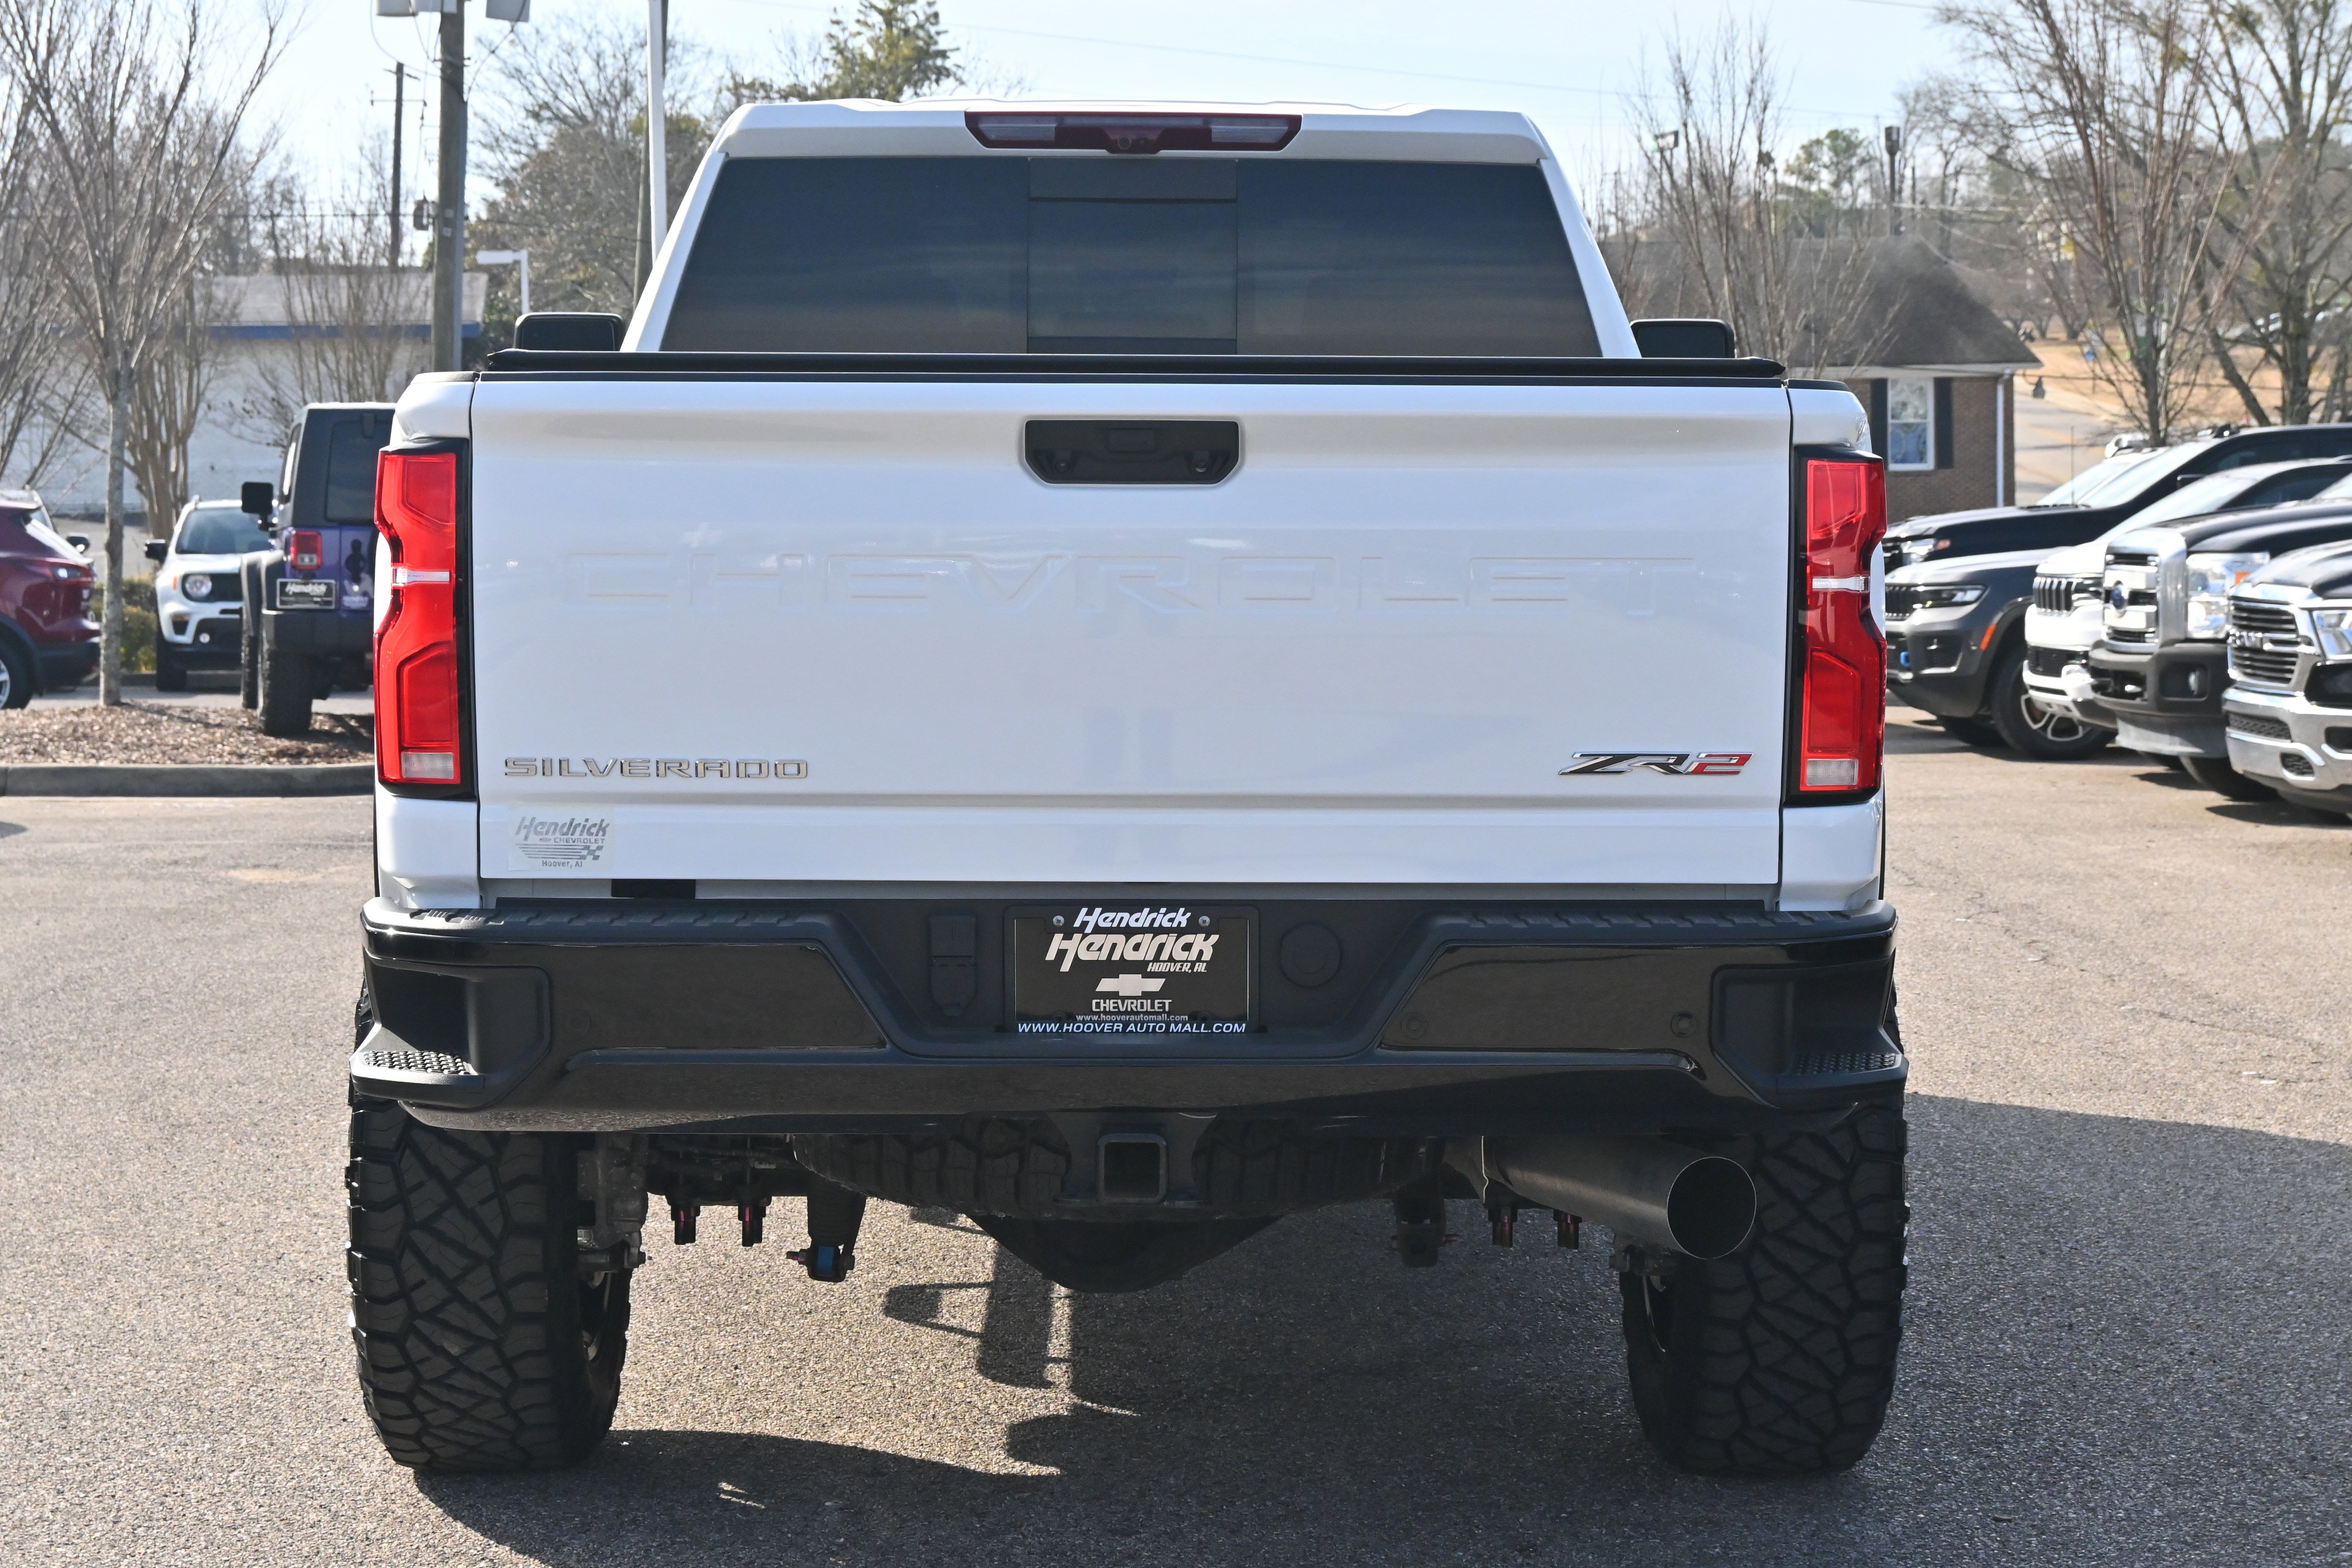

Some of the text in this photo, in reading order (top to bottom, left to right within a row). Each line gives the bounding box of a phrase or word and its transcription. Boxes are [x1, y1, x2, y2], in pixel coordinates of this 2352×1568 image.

[565, 552, 1696, 614] CHEVROLET
[505, 758, 808, 779] SILVERADO
[1558, 751, 1754, 776] ZR2
[515, 817, 610, 841] Hendrick
[542, 860, 572, 868] Hoover,
[1073, 908, 1191, 933] Hendrick
[1045, 934, 1219, 972] Hendrick
[1147, 962, 1207, 973] HOOVER, AL
[1092, 999, 1172, 1012] CHEVROLET
[1018, 1023, 1246, 1032] WWW.HOOVER AUTO MALL.COM
